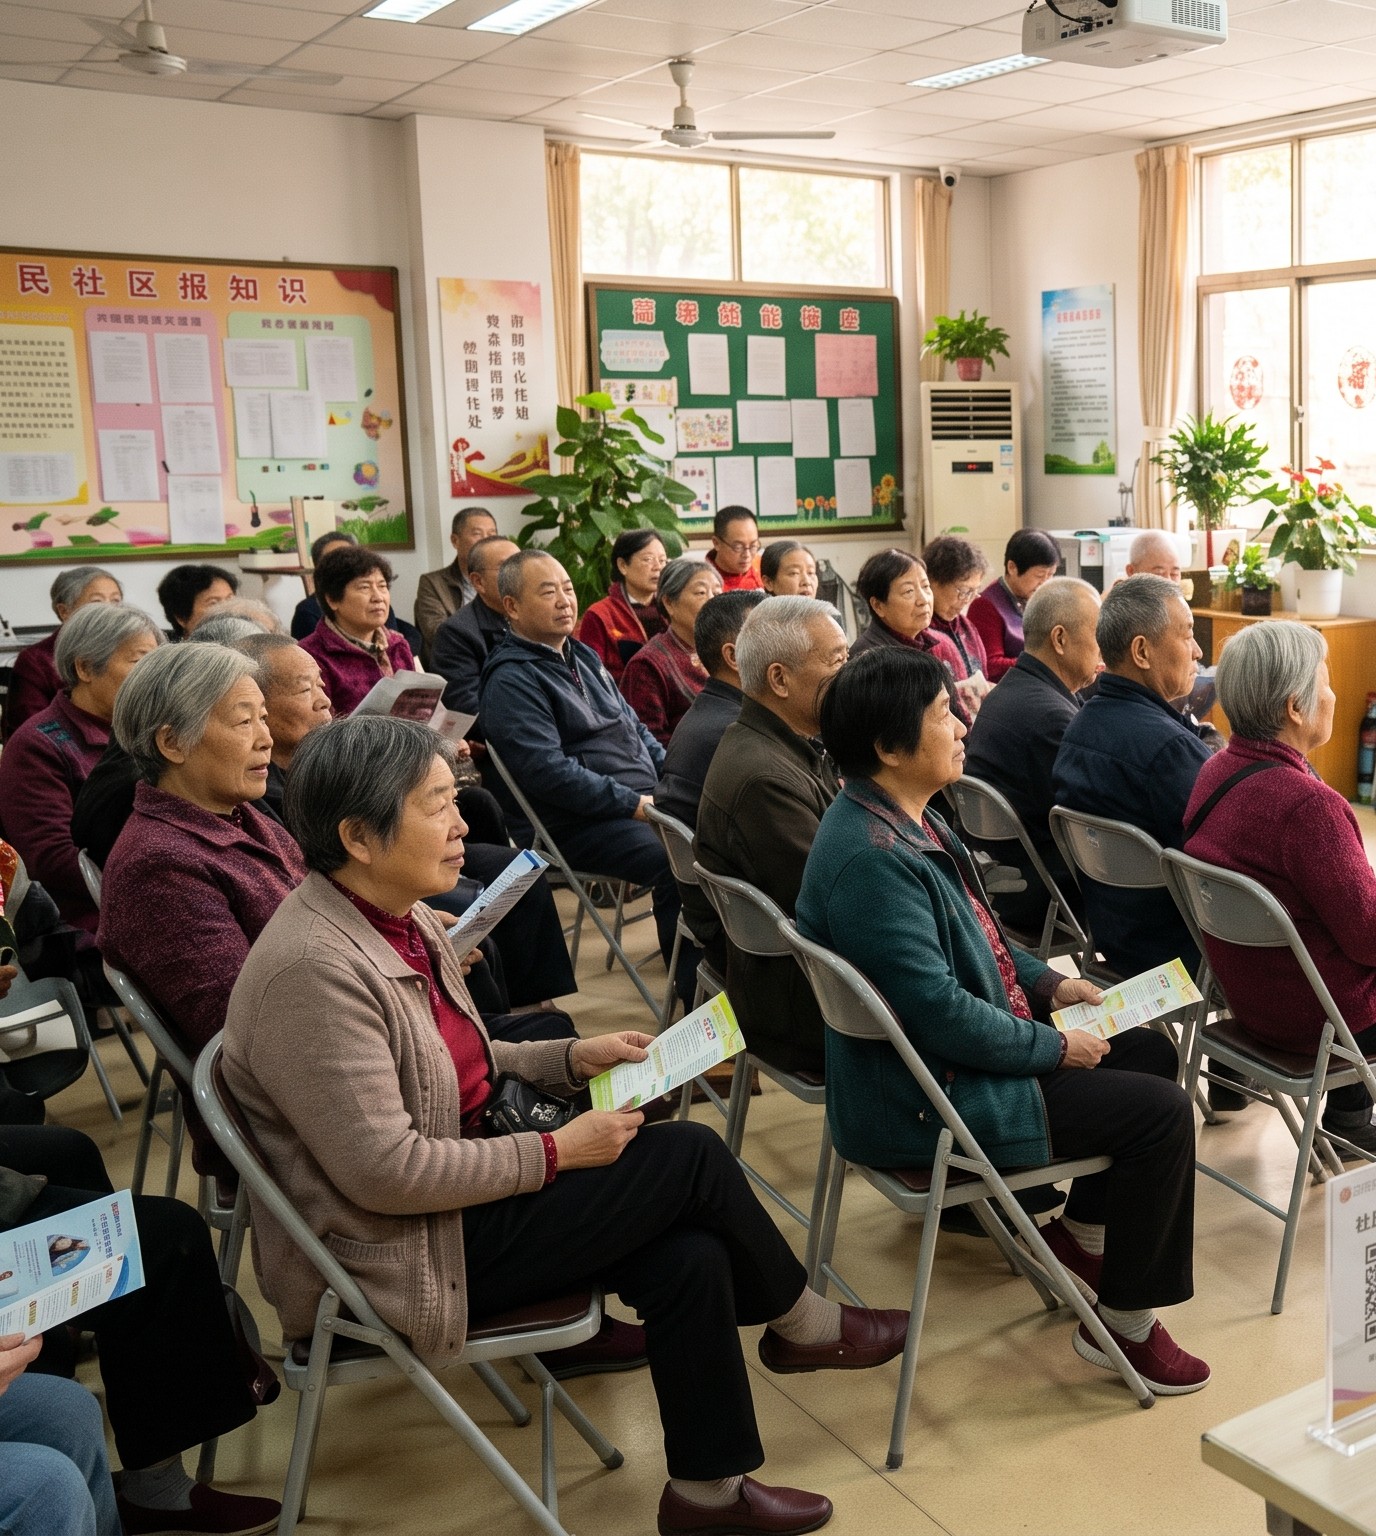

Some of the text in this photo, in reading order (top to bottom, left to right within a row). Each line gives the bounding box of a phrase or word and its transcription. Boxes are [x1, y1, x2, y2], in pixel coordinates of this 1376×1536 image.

[17, 263, 308, 304] 民社区报知识
